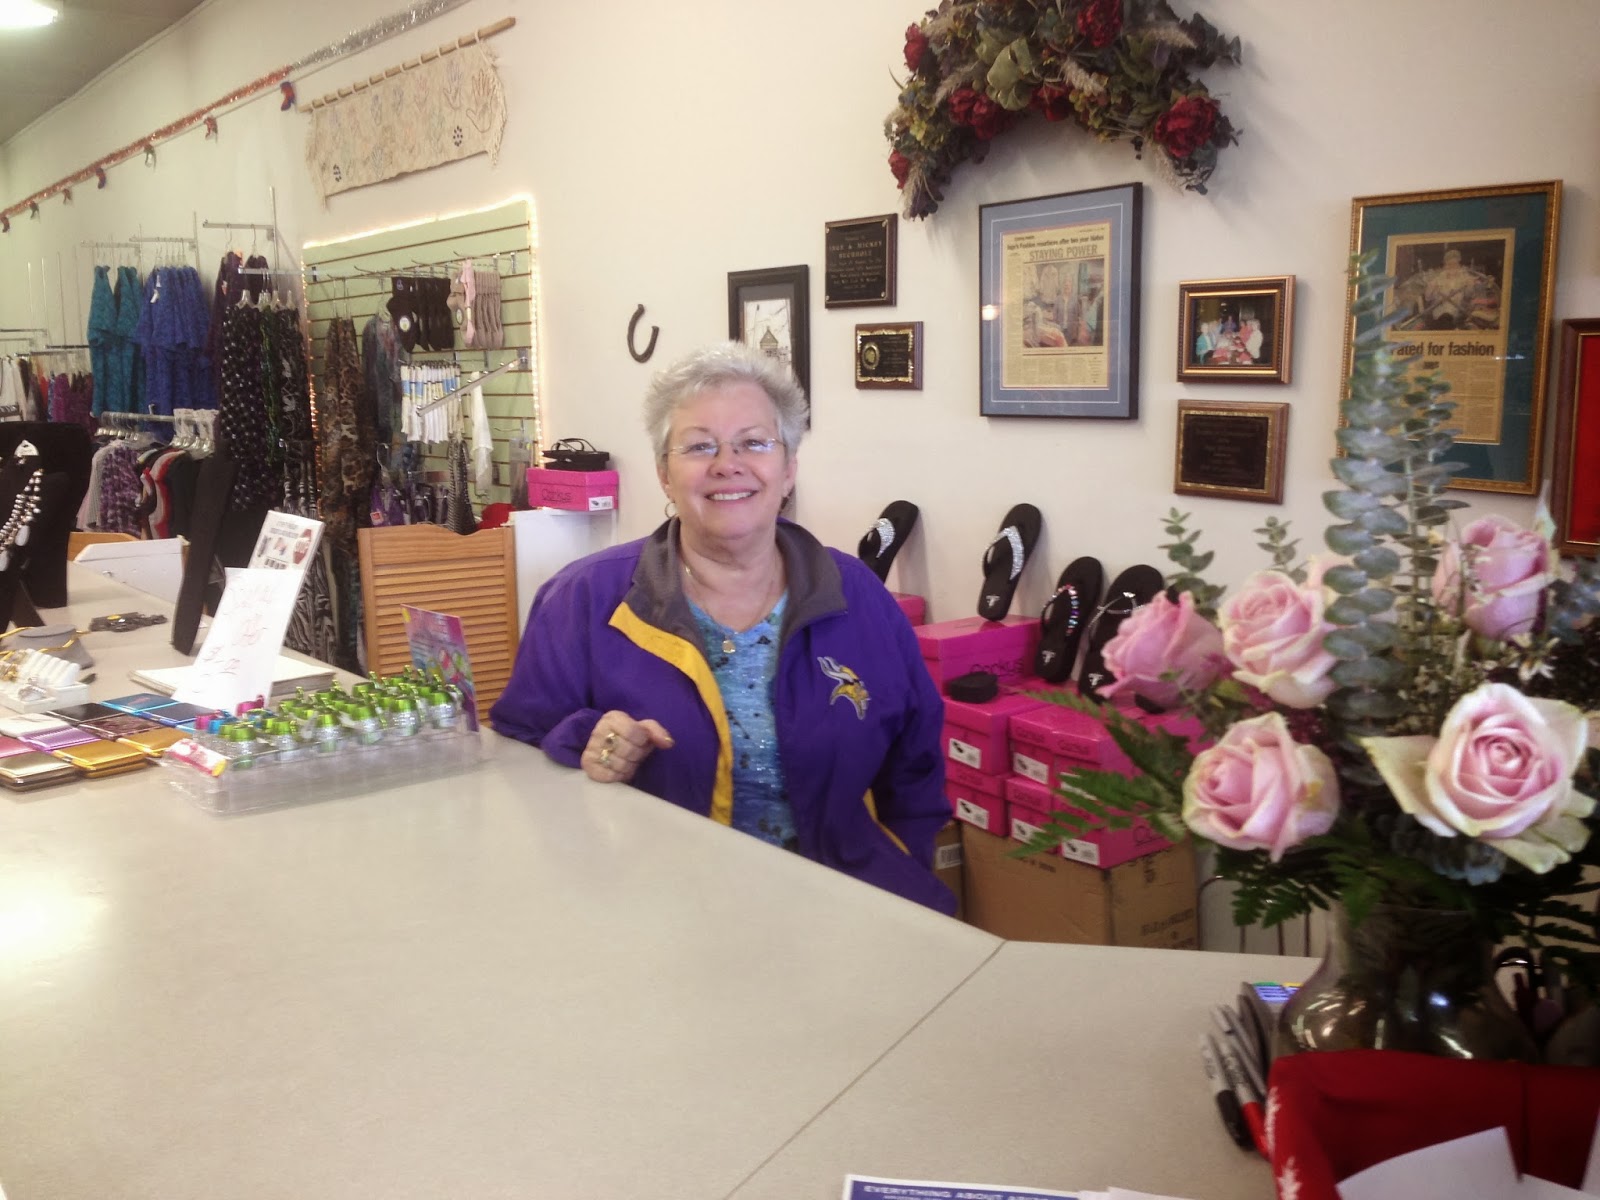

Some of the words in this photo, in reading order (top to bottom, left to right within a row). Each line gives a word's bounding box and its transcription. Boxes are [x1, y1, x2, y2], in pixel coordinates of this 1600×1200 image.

[1029, 247, 1063, 262] STAYING
[1066, 244, 1098, 257] POWER
[1390, 341, 1424, 356] ated
[1427, 341, 1445, 356] for
[1448, 341, 1495, 356] fashion
[863, 1185, 951, 1198] EVERYTHING
[954, 1192, 1004, 1200] ABOUT
